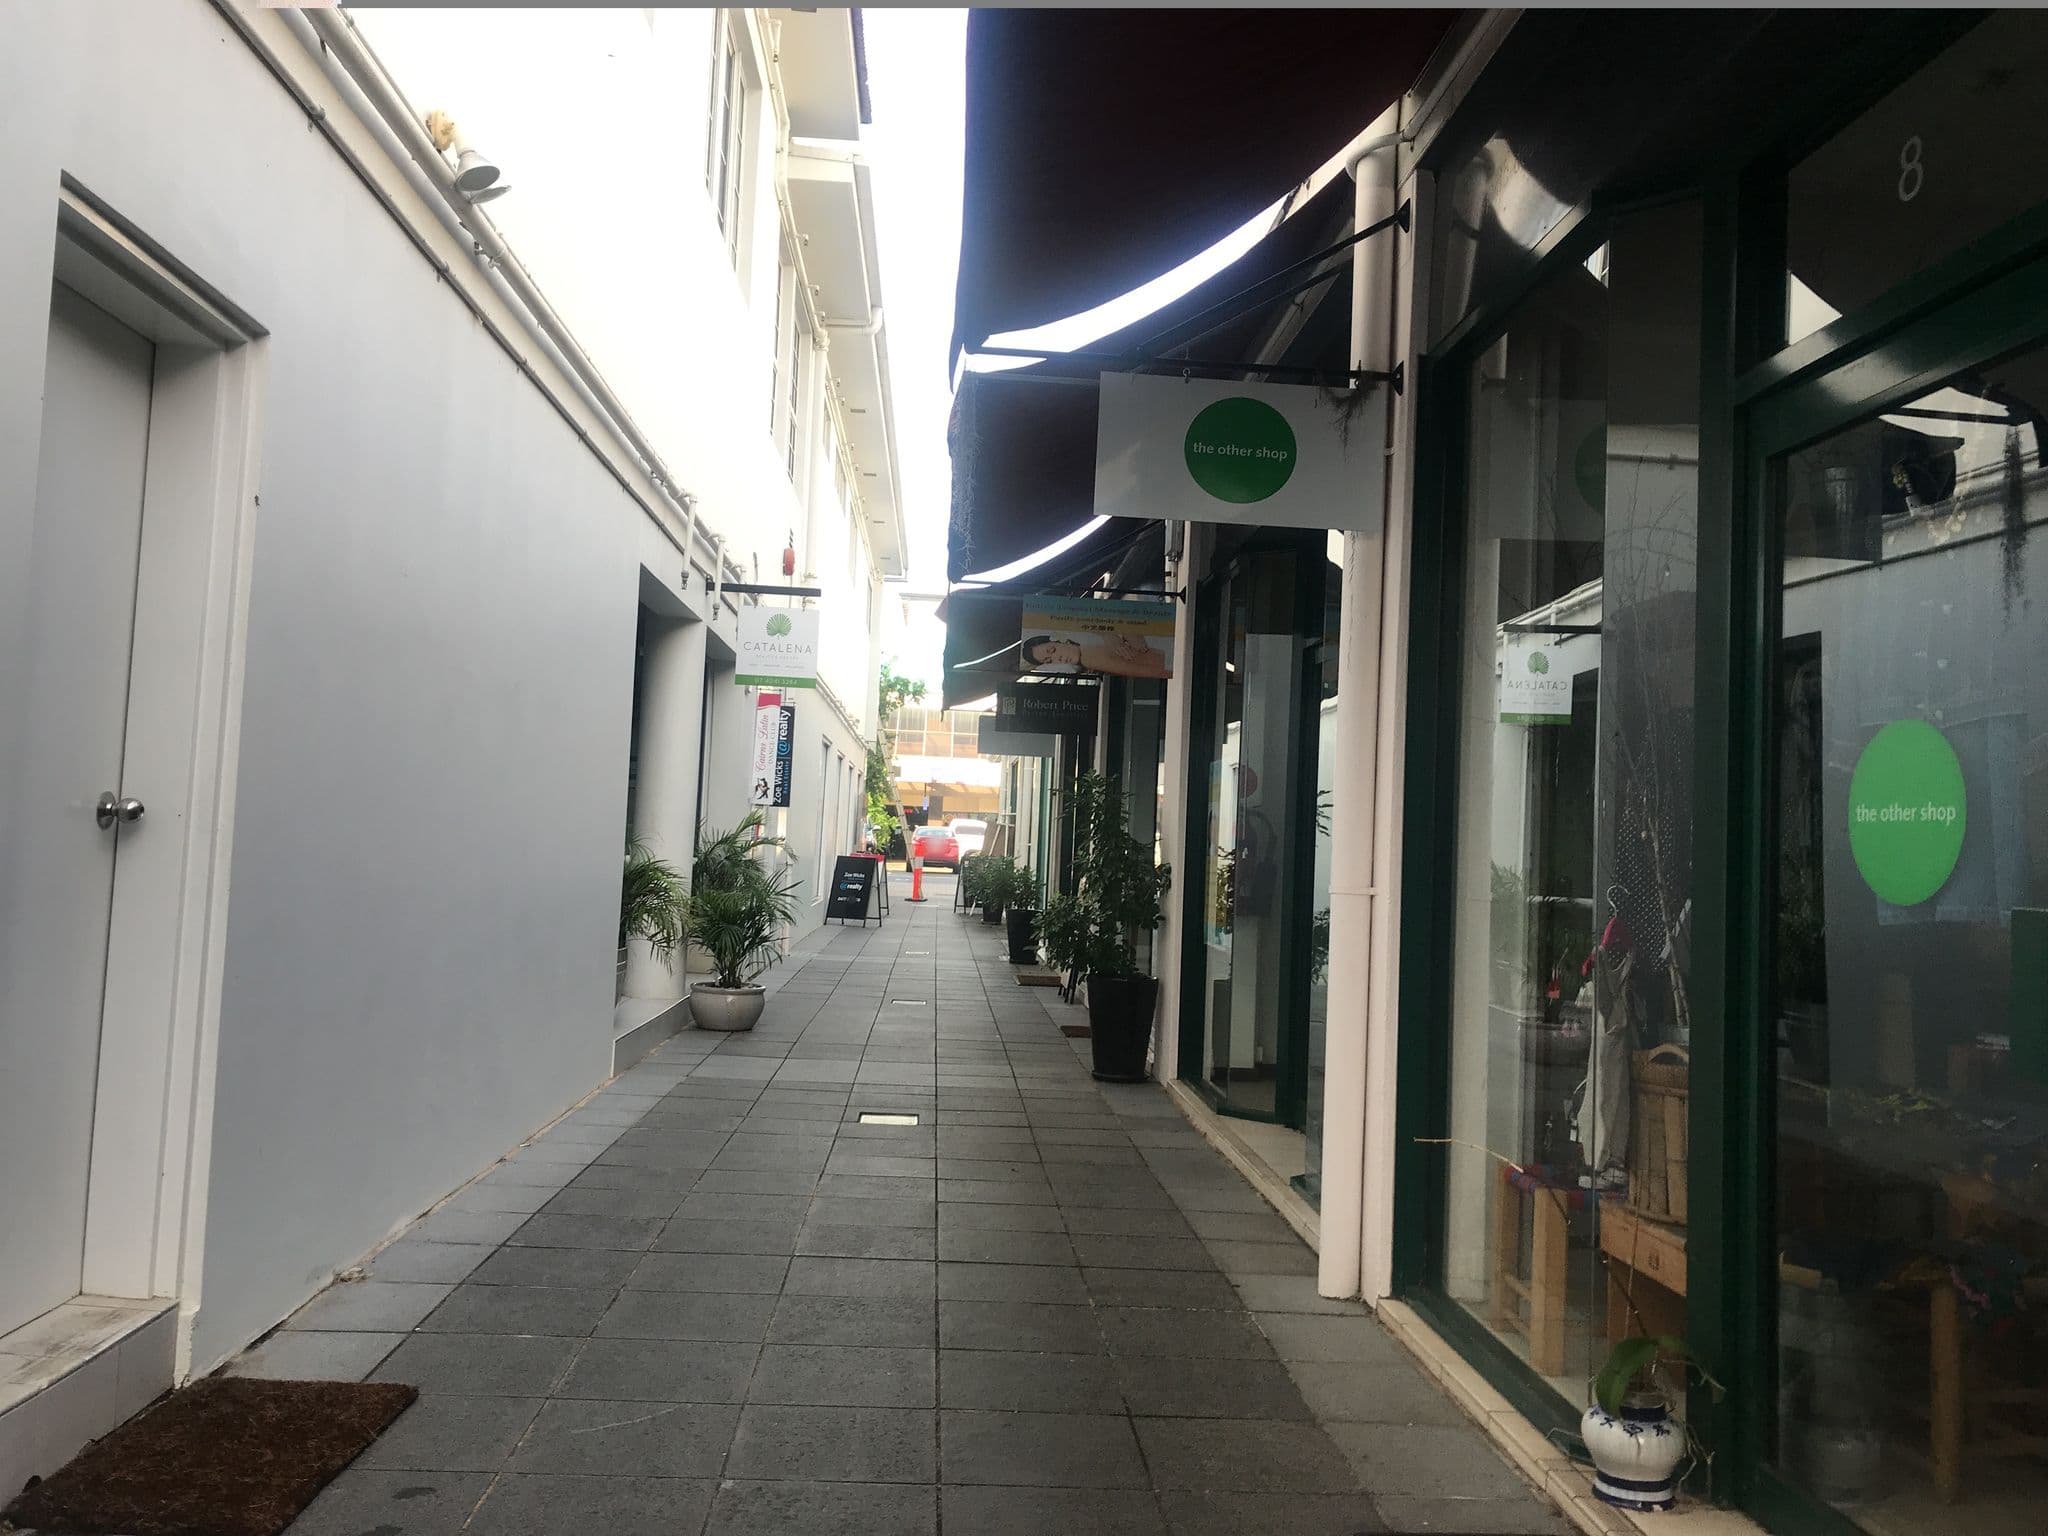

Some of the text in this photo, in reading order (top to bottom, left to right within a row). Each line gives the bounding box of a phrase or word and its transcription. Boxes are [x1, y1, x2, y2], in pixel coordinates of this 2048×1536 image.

[1899, 136, 1923, 202] 8
[1193, 442, 1288, 461] the other shop
[744, 641, 812, 654] CATALENA
[1023, 697, 1057, 710] Robert
[1062, 699, 1088, 711] Price
[777, 710, 792, 756] @realty
[774, 760, 784, 803] Zoe Wicks
[1856, 801, 1956, 826] the other shop
